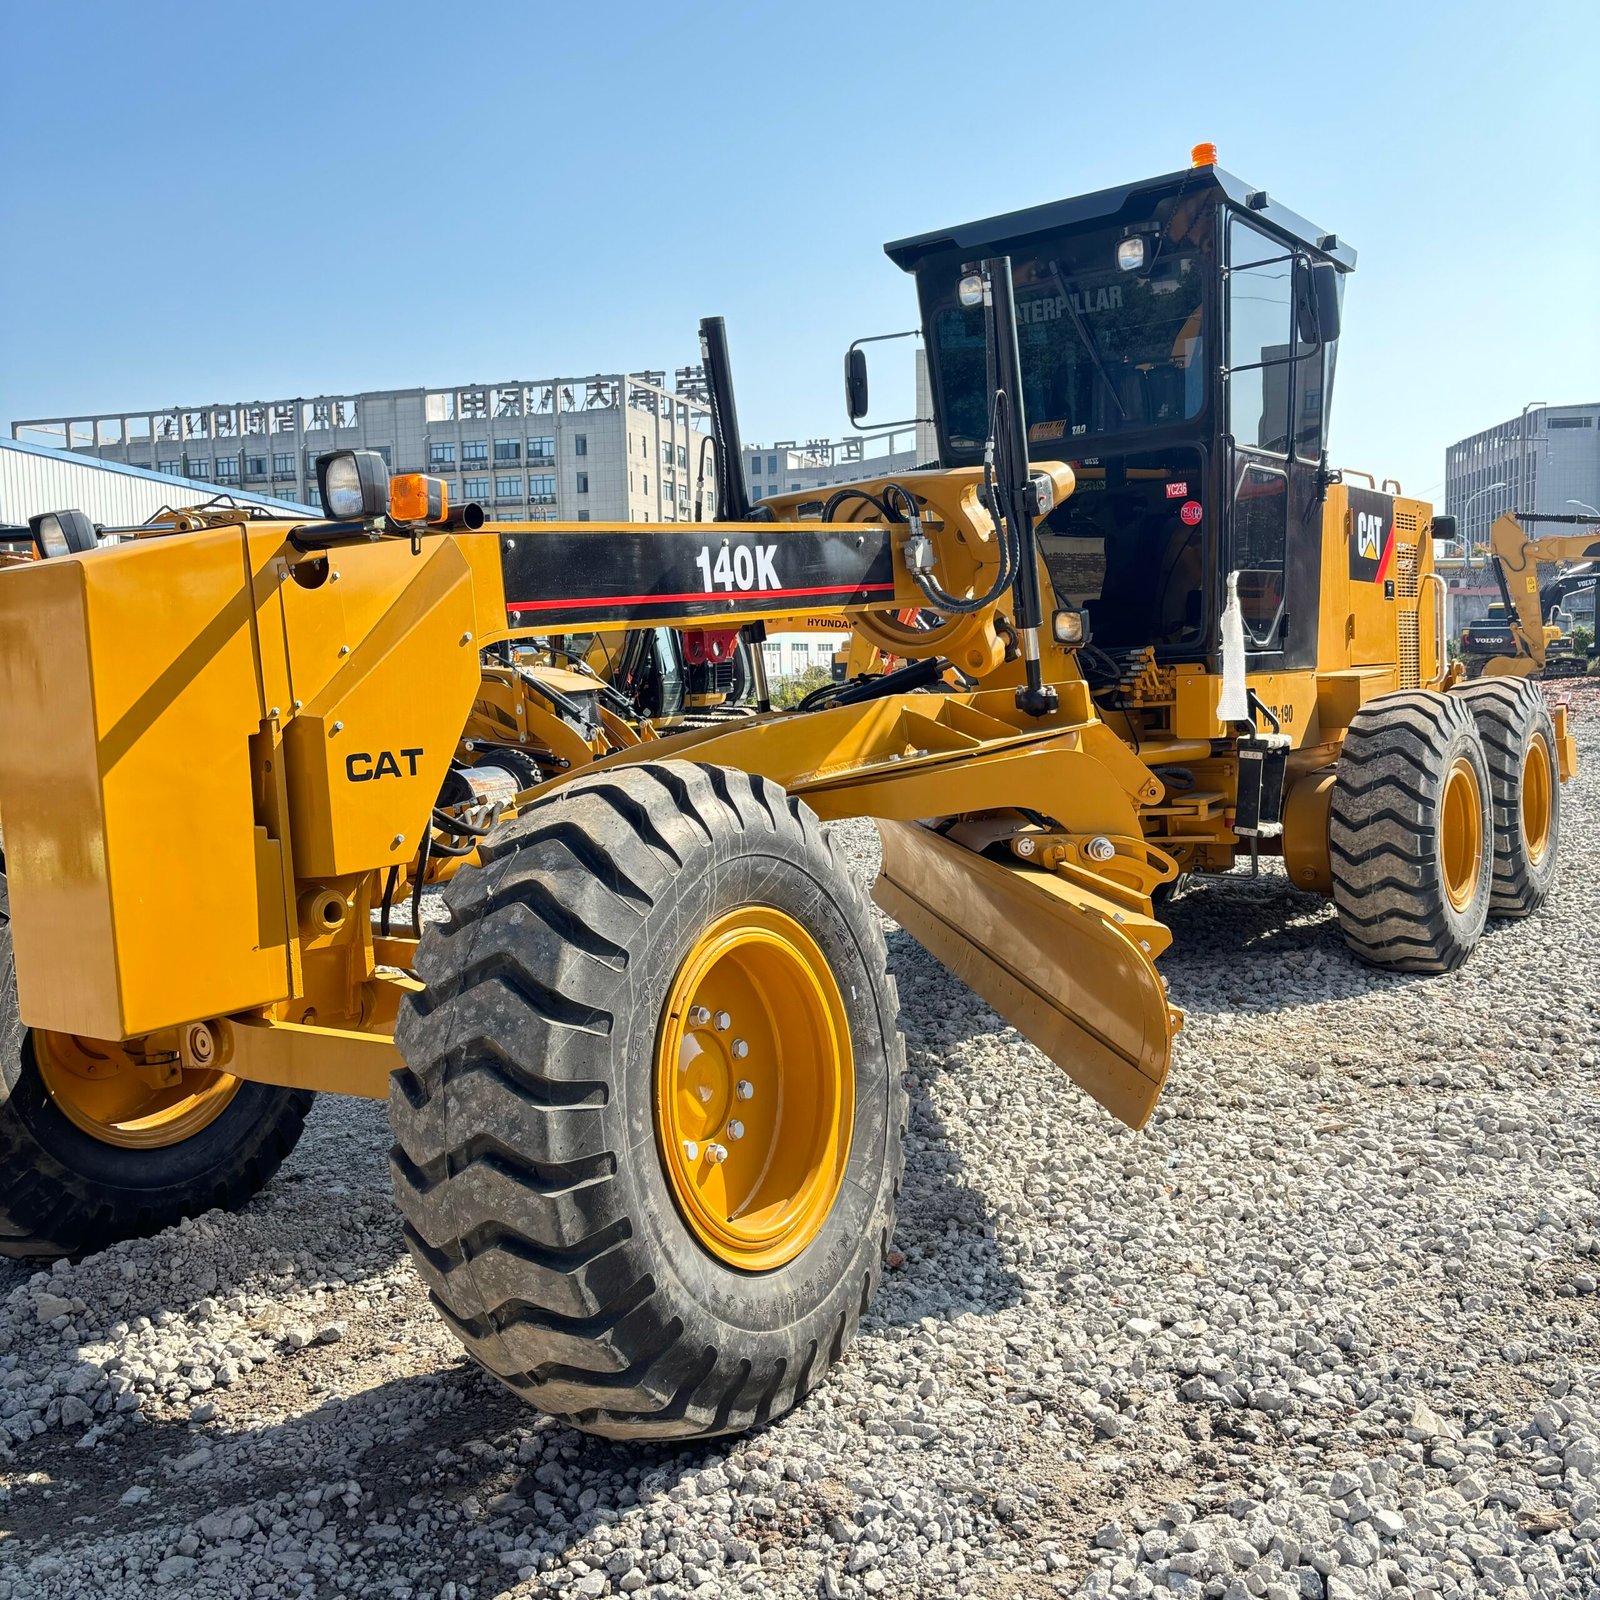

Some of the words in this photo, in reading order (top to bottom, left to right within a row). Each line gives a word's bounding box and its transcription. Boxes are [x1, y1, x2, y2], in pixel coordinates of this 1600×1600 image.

[1015, 286, 1123, 324] ATERPILLAR
[1166, 482, 1187, 496] YC236
[1358, 511, 1383, 560] CAT
[696, 545, 783, 593] 140K
[1577, 578, 1597, 587] VOLVO
[346, 748, 424, 782] CAT
